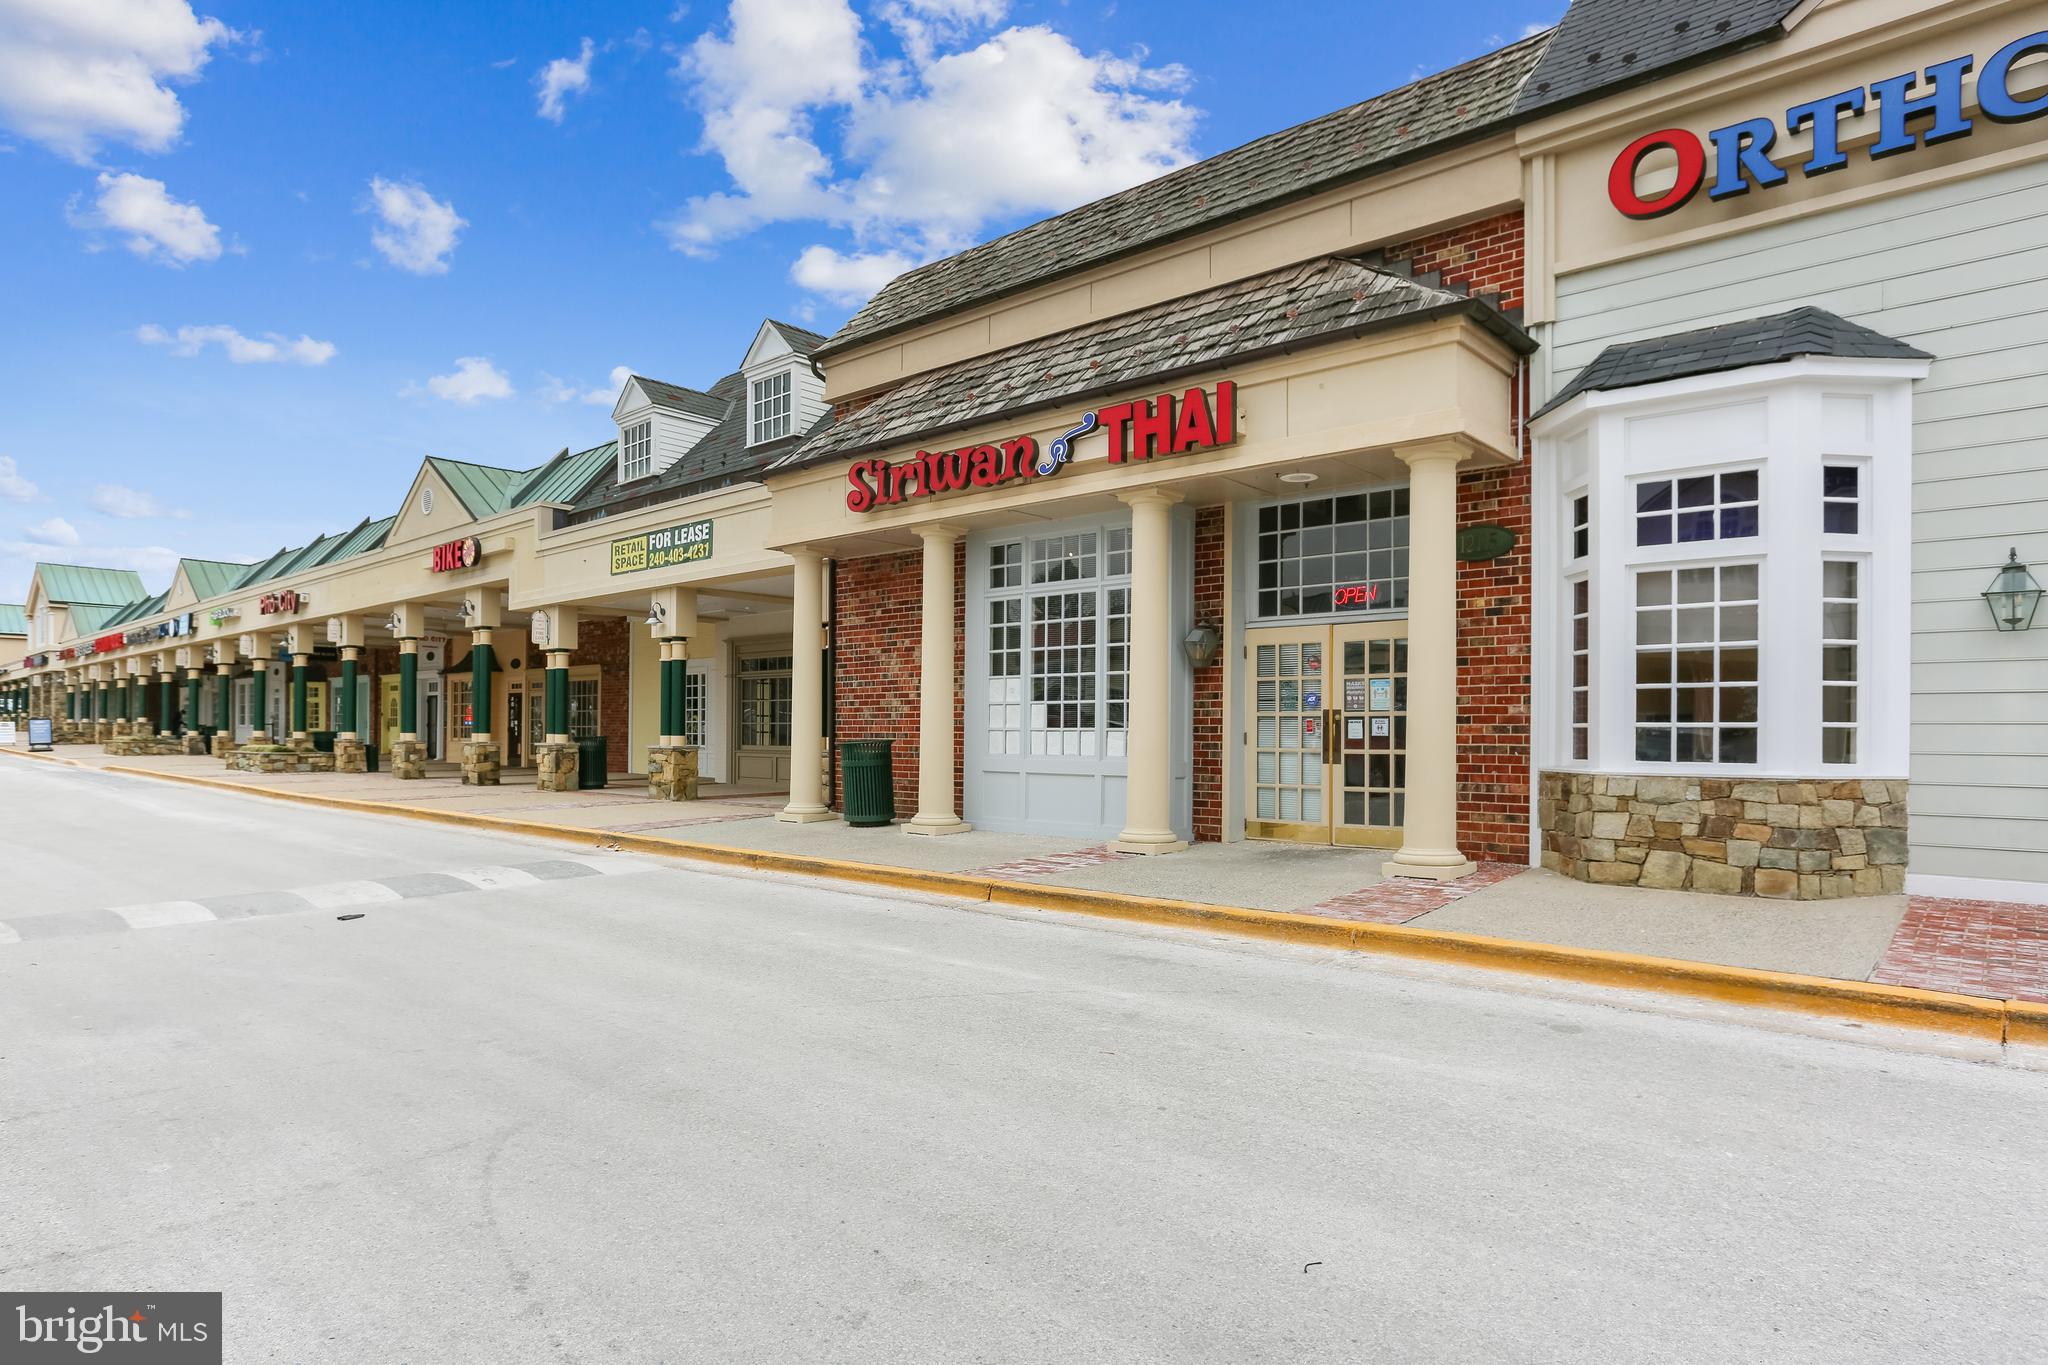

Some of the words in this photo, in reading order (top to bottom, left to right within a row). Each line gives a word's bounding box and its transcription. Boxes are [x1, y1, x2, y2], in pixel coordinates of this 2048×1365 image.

[845, 433, 1039, 513] Siriwan
[1098, 380, 1238, 465] THAI
[614, 540, 646, 556] RETAIL
[649, 531, 671, 551] FOR
[674, 522, 710, 546] LEASE
[433, 540, 463, 573] BIKE
[614, 553, 644, 570] SPACE
[648, 542, 709, 567] 240-403-4231
[1334, 584, 1377, 605] OPEN
